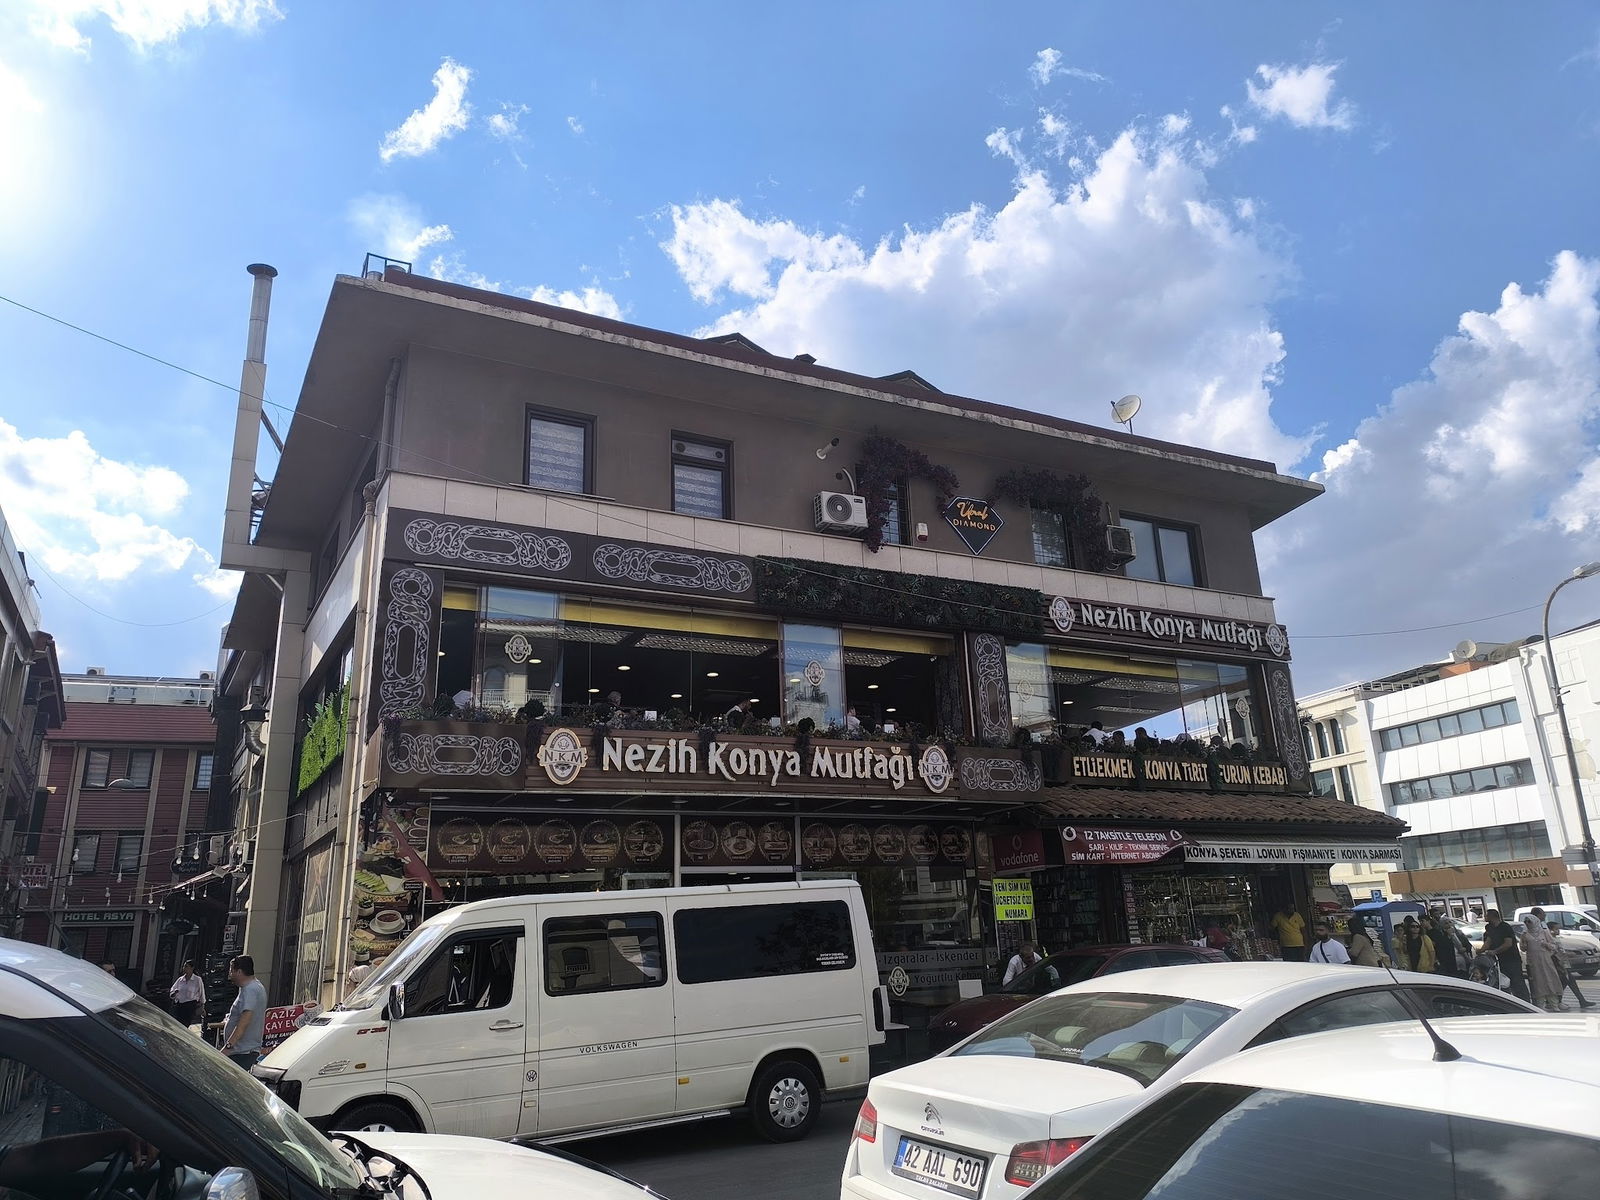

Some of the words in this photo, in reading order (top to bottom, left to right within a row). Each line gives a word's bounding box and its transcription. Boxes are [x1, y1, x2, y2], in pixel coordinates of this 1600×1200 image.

[953, 519, 995, 531] DIAMOND
[1081, 603, 1136, 631] Nezih
[1141, 611, 1195, 643] Konya
[1201, 619, 1262, 651] Mutfağı
[545, 750, 582, 763] N.K.M
[602, 737, 697, 773] Nezih
[708, 741, 801, 787] Konya
[811, 746, 914, 790] Mutfağı
[1145, 760, 1181, 781] KONYA
[1182, 762, 1208, 782] TİRİT
[1253, 766, 1289, 785] KEBABI
[1084, 830, 1093, 840] 12
[1096, 830, 1132, 840] TAKSİTLE
[1132, 832, 1167, 841] TELEFON
[1001, 852, 1039, 866] vodafone
[1072, 852, 1085, 861] SİM
[1086, 852, 1105, 861] KART
[1110, 852, 1140, 860] İNTERNET
[1186, 847, 1217, 858] KONYA
[1219, 849, 1251, 861] ŞEKERİ
[1257, 849, 1287, 859] LOKUM
[1293, 849, 1336, 862] PİŞMANİYE
[1342, 850, 1368, 859] KONYA
[1368, 850, 1402, 859] SARMASI
[1499, 867, 1547, 879] HALKBANK
[103, 912, 134, 920] ASYA
[265, 1020, 283, 1033] ÇAY
[579, 1041, 638, 1054] VOLKSWAGEN
[904, 1145, 921, 1169] 42
[922, 1149, 946, 1177] AAL
[952, 1157, 981, 1187] 690
